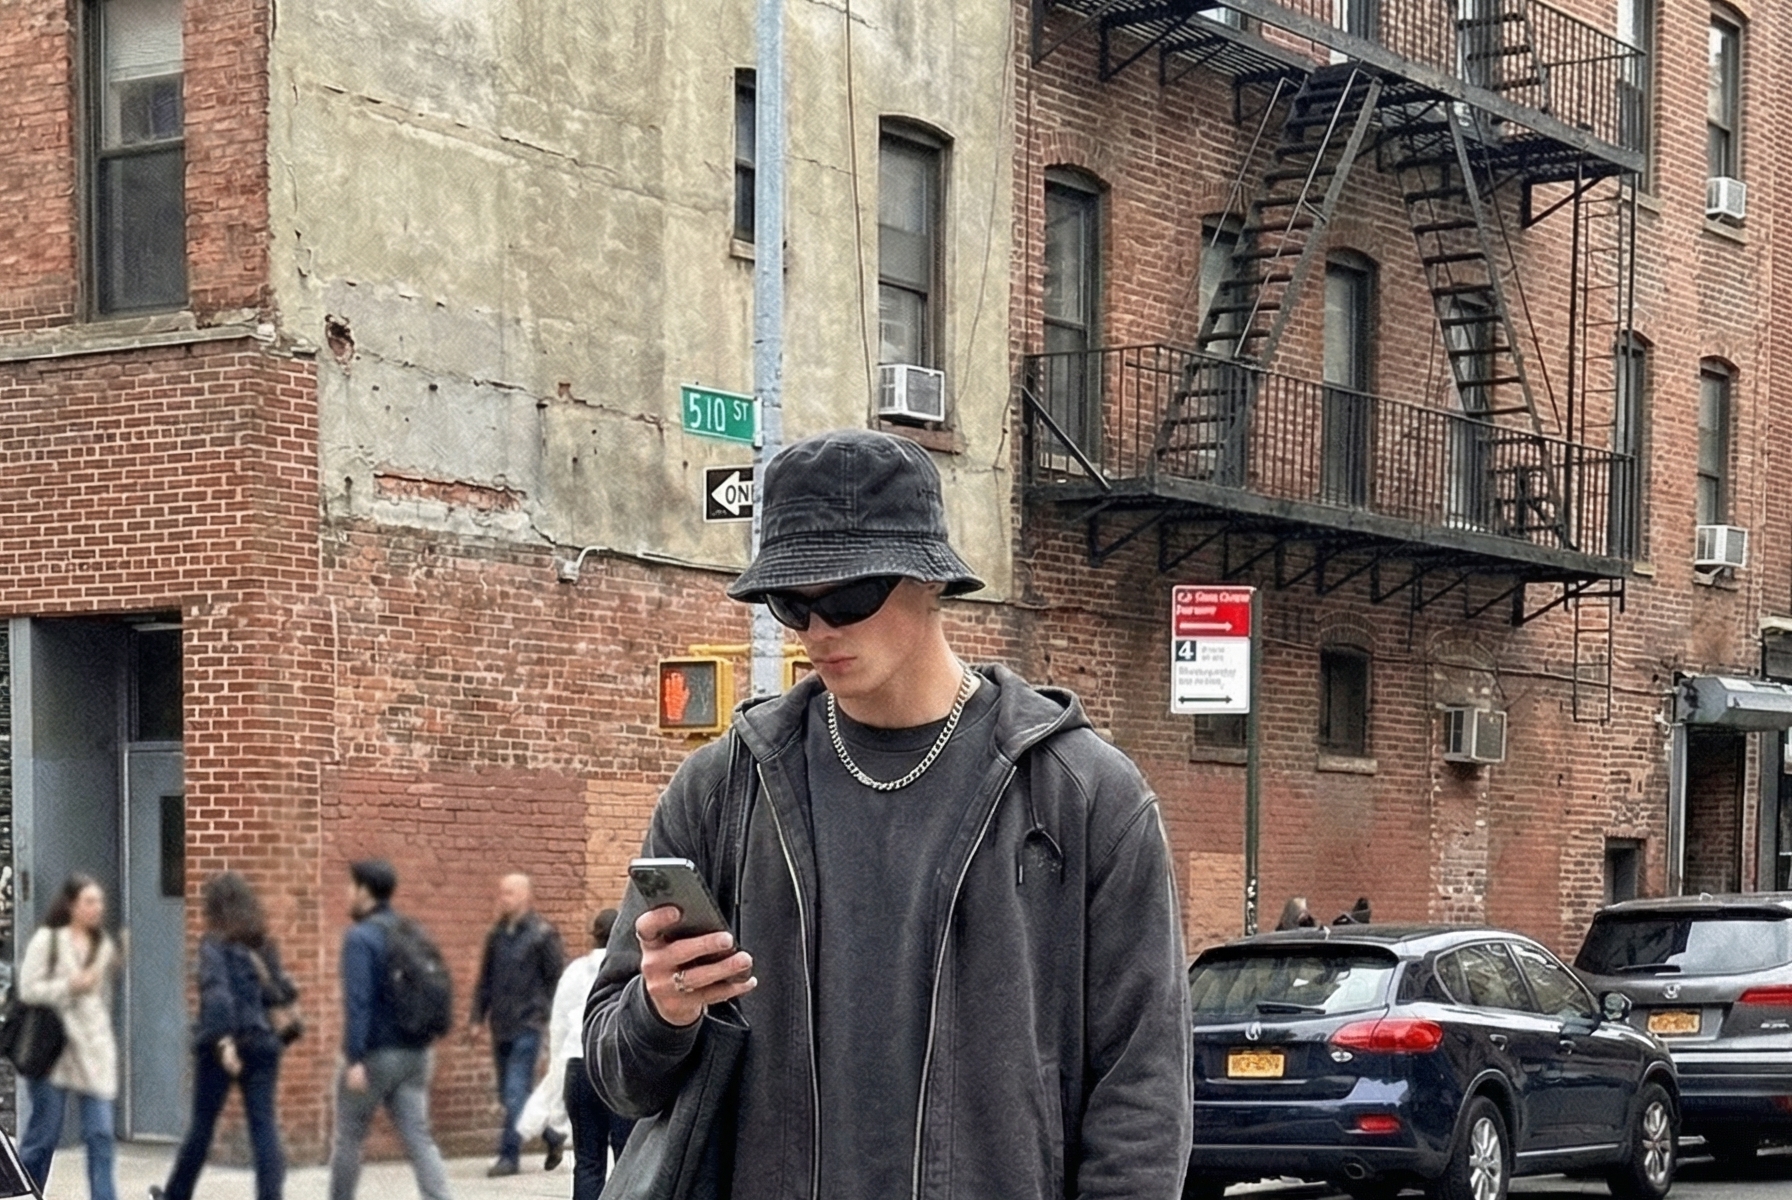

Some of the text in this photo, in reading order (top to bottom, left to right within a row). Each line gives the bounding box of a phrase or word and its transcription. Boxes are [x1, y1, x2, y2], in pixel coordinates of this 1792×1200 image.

[689, 392, 749, 432] 510 ST
[725, 484, 754, 505] ON
[1178, 641, 1194, 660] 4
